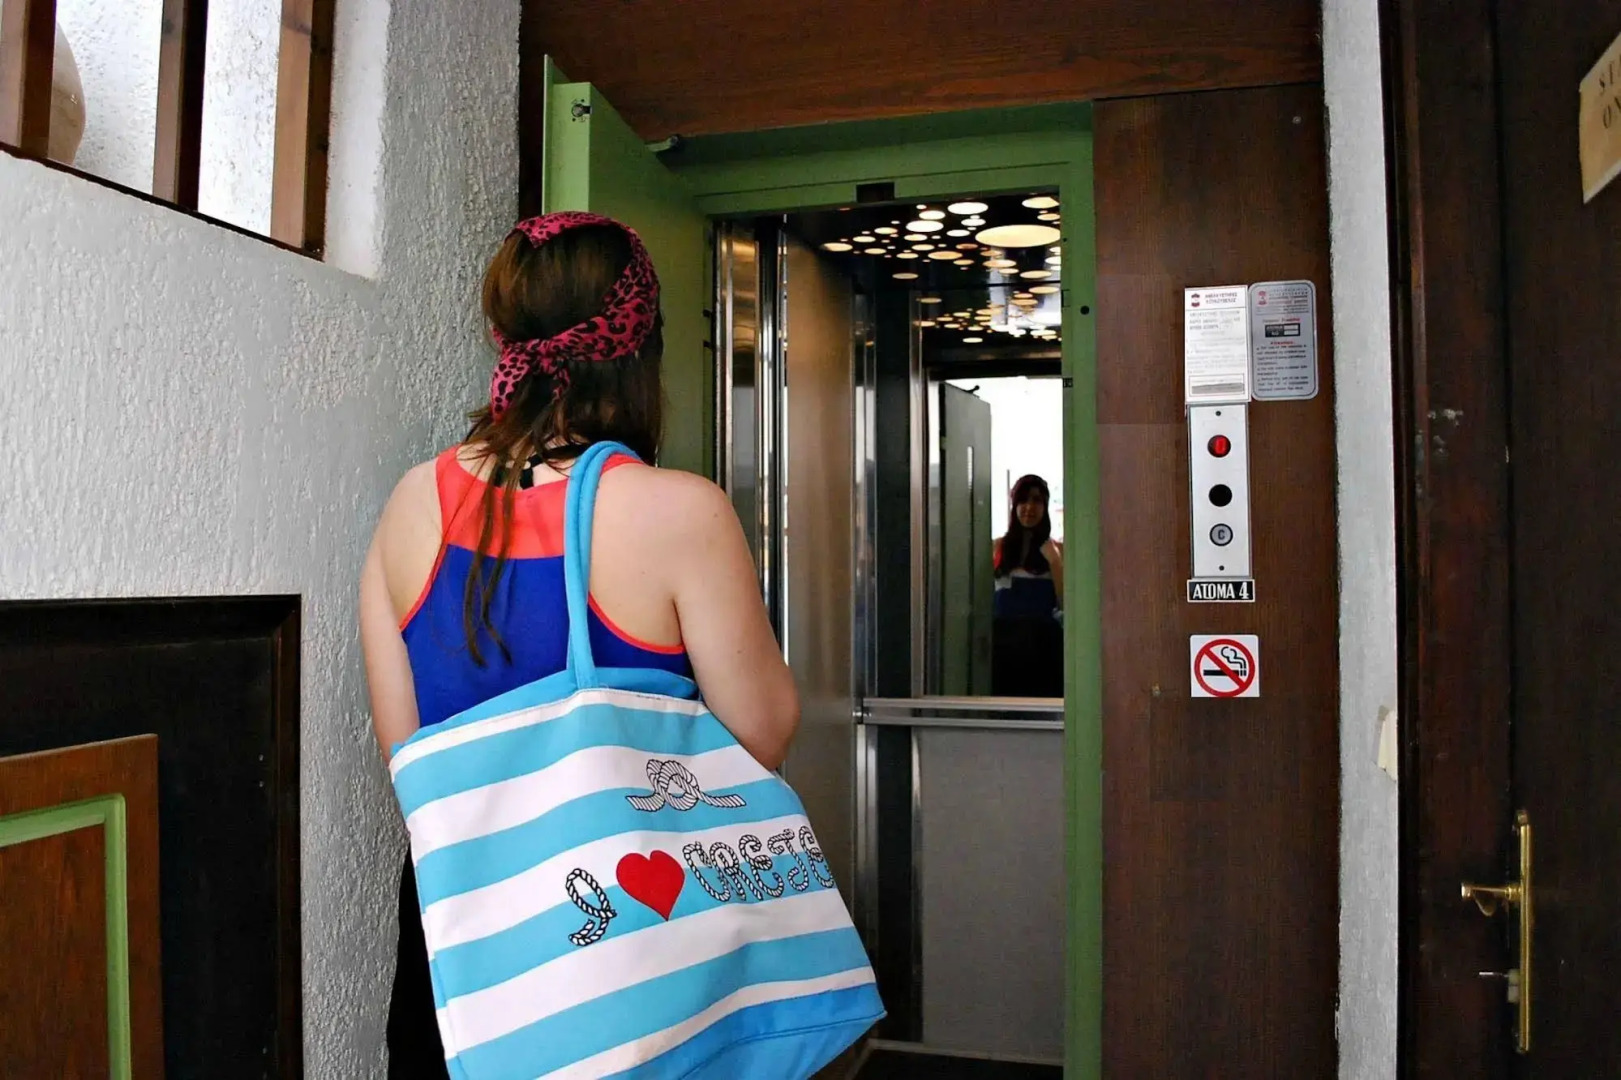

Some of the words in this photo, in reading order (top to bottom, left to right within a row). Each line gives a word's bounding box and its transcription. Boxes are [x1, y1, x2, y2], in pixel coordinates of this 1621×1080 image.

[1599, 54, 1621, 96] ST
[1217, 529, 1225, 540] C
[1192, 583, 1235, 599] ΑΤΟΜΑ
[1239, 581, 1249, 599] 4
[682, 826, 834, 902] CRETE
